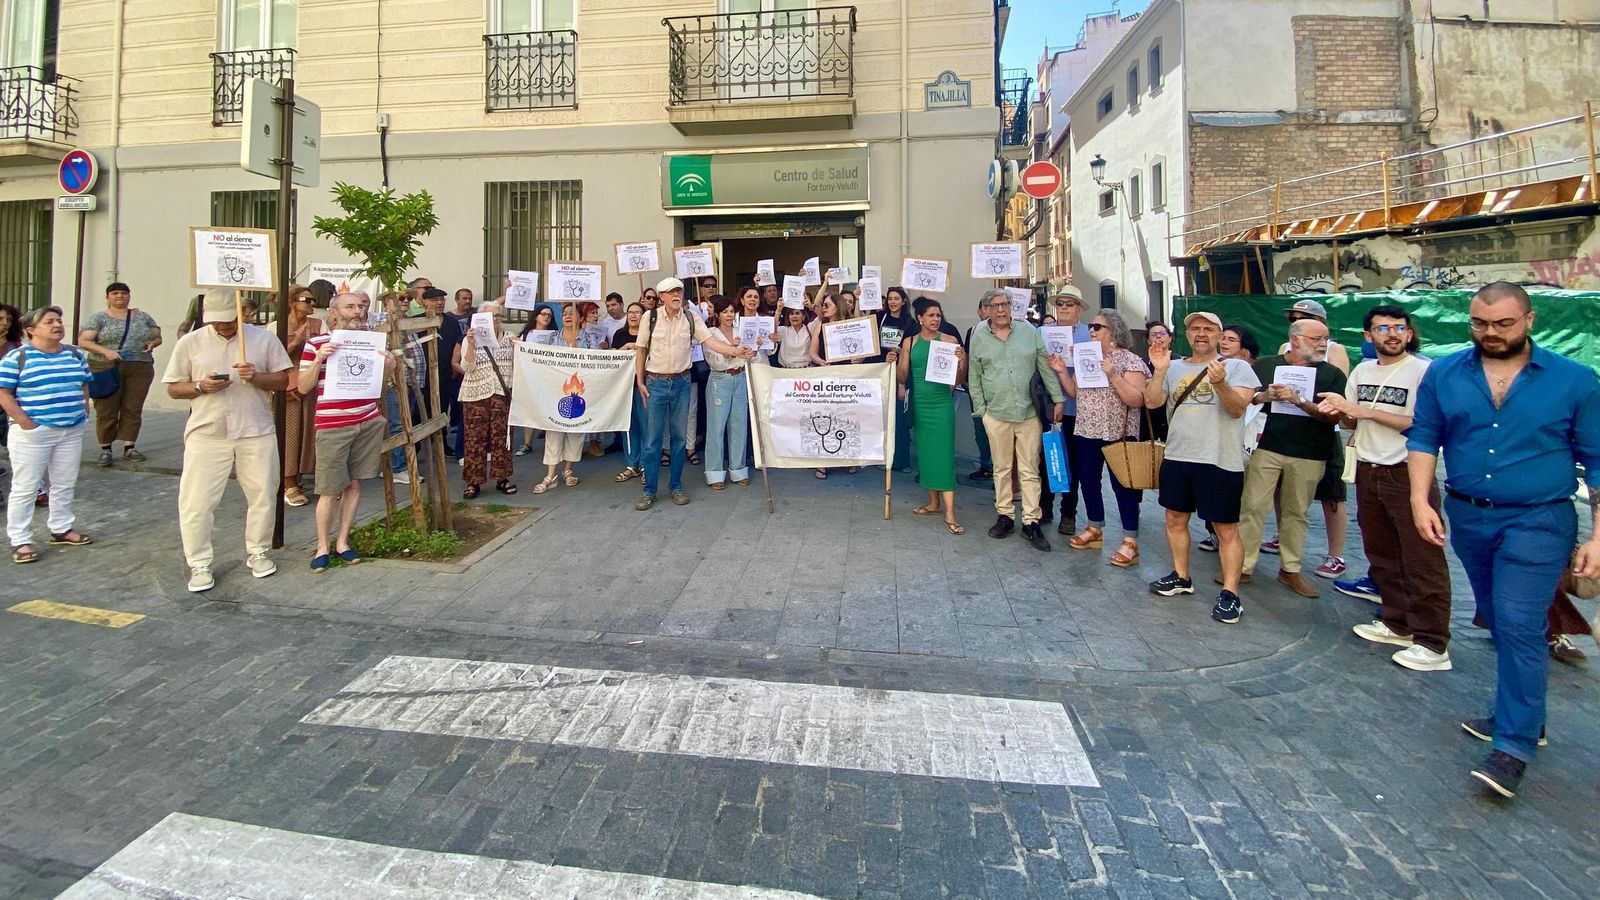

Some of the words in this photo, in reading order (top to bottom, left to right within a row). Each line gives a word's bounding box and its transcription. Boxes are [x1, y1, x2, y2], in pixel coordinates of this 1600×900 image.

[929, 89, 967, 103] TINAJILLA
[774, 169, 808, 182] Centro
[812, 168, 825, 181] de
[828, 166, 859, 180] Salud
[213, 234, 225, 242] NO
[234, 235, 253, 243] cierre
[881, 331, 902, 339] PEPA
[528, 348, 555, 358] ALBAYZÍN
[556, 352, 578, 360] CONTRA
[579, 353, 586, 361] EL
[557, 361, 579, 369] AGAINST
[793, 381, 811, 391] NO
[813, 381, 823, 392] al
[826, 381, 857, 392] cierre
[833, 391, 872, 400] Fortuny-Velutti
